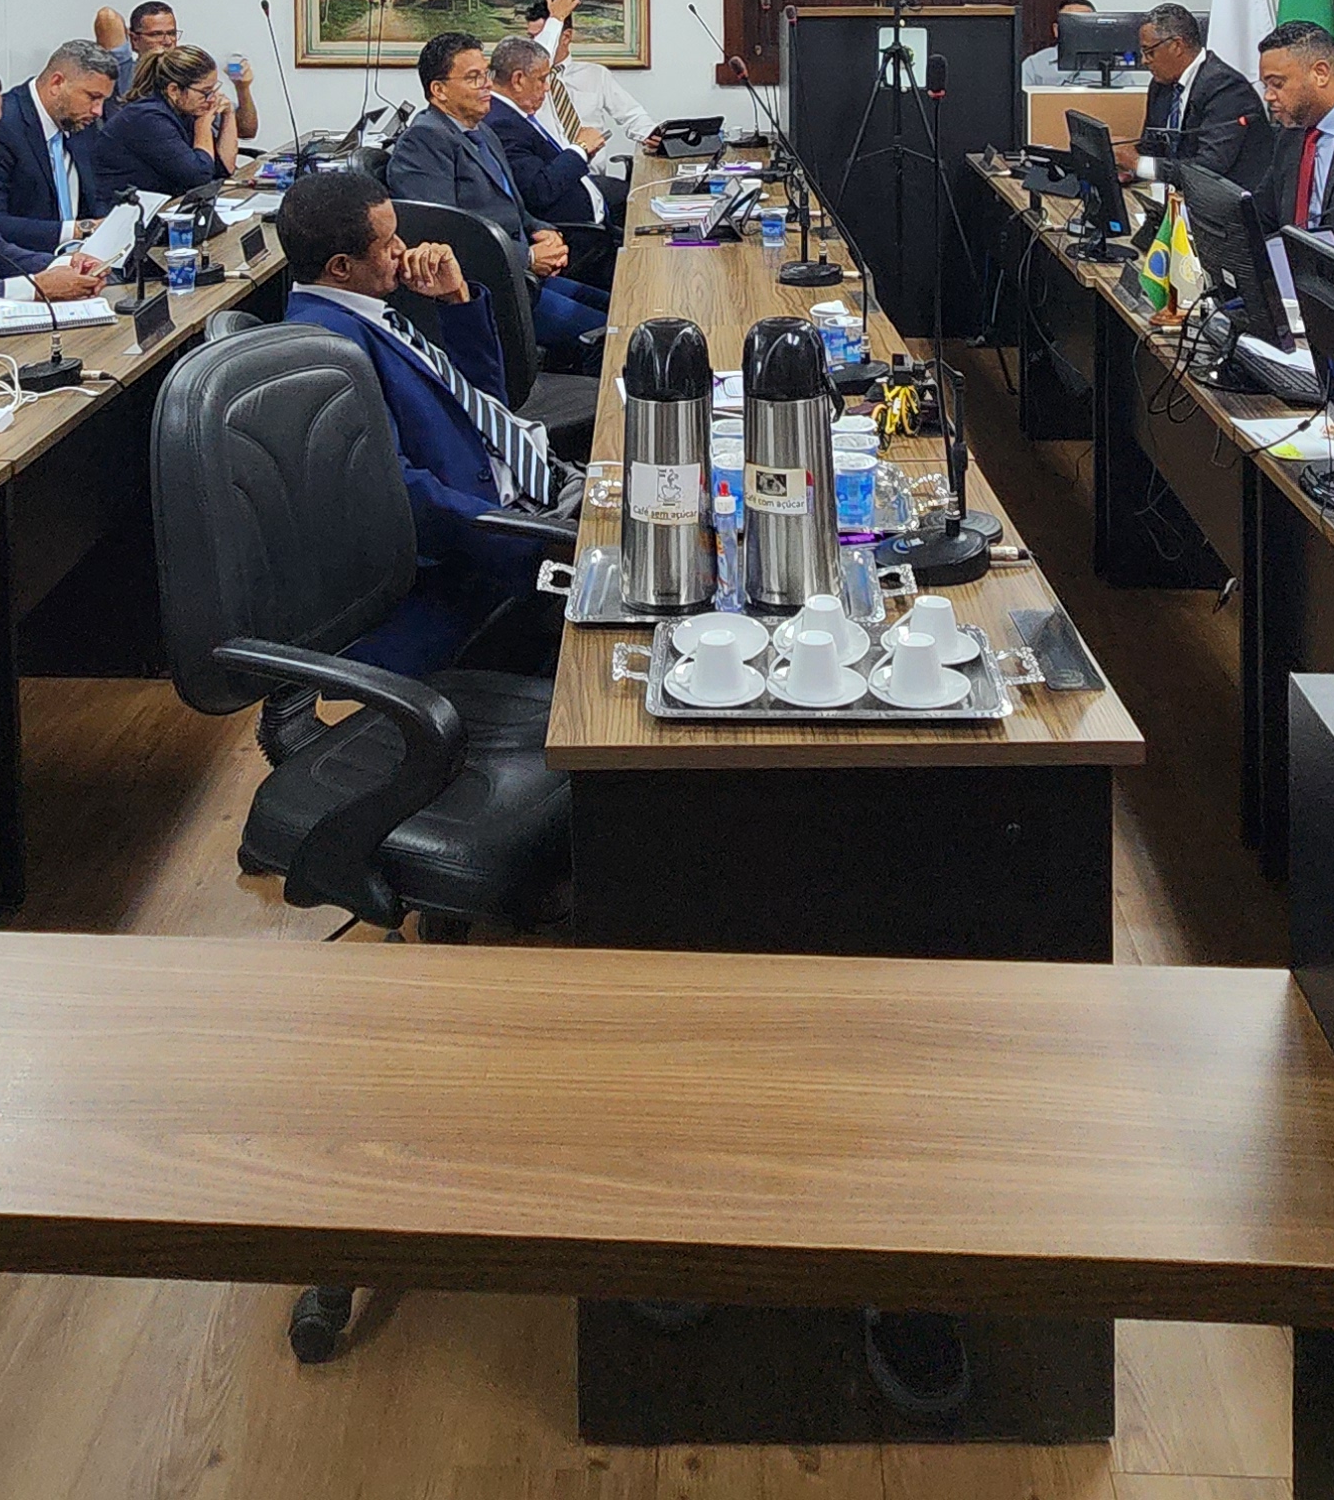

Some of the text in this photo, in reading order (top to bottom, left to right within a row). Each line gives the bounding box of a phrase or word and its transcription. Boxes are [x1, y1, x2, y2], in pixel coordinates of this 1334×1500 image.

[776, 496, 805, 509] açúcar
[632, 504, 698, 521] Café sem açúcar
